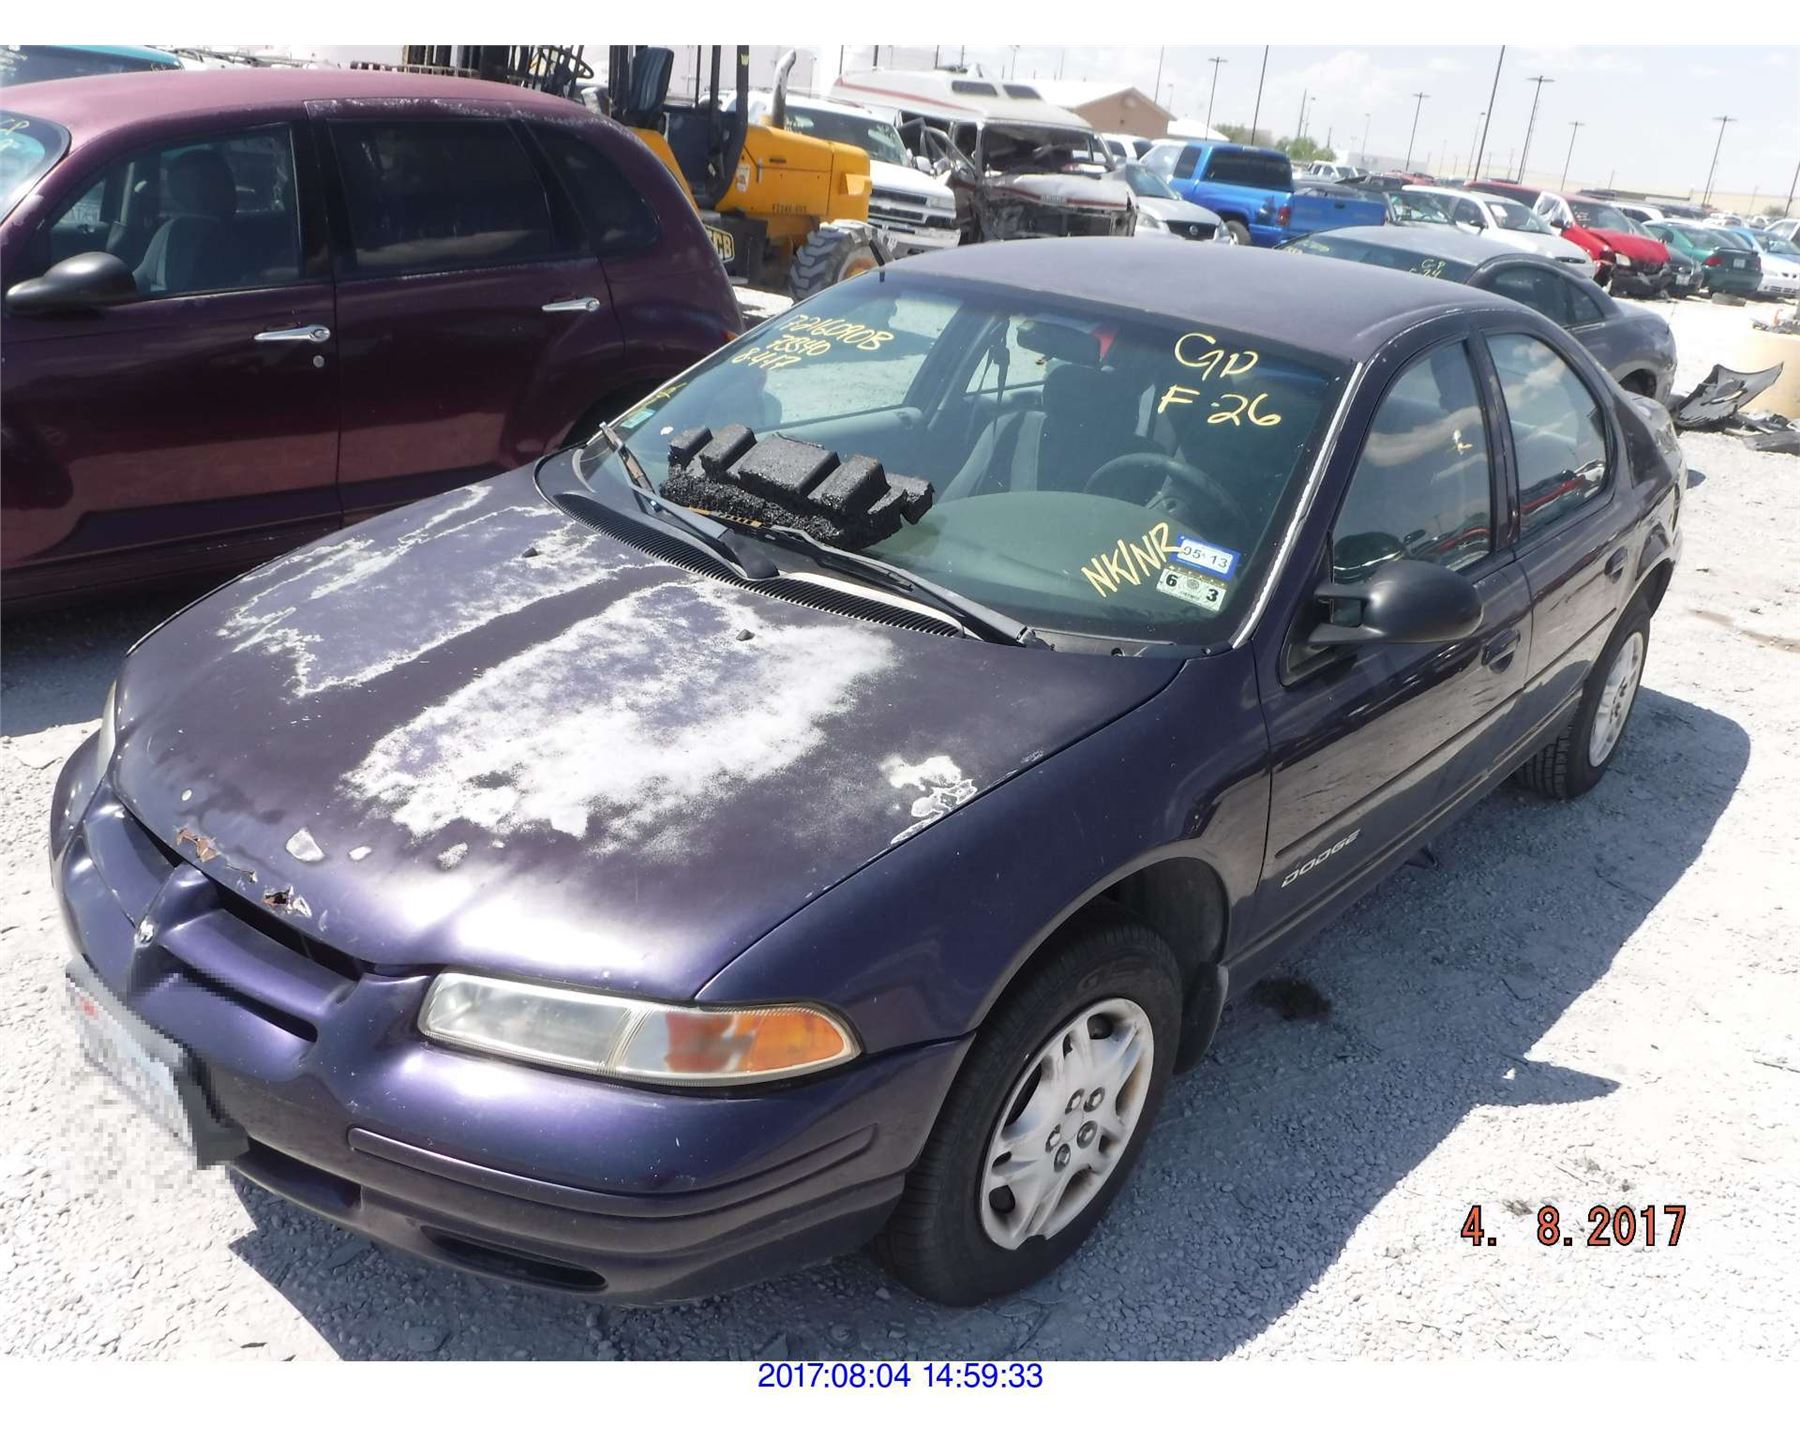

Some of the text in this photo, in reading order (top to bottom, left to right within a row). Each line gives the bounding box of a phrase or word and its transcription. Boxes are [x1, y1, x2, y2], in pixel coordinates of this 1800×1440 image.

[1166, 574, 1178, 587] 6
[1206, 588, 1219, 602] 3
[1281, 829, 1361, 888] DODGE
